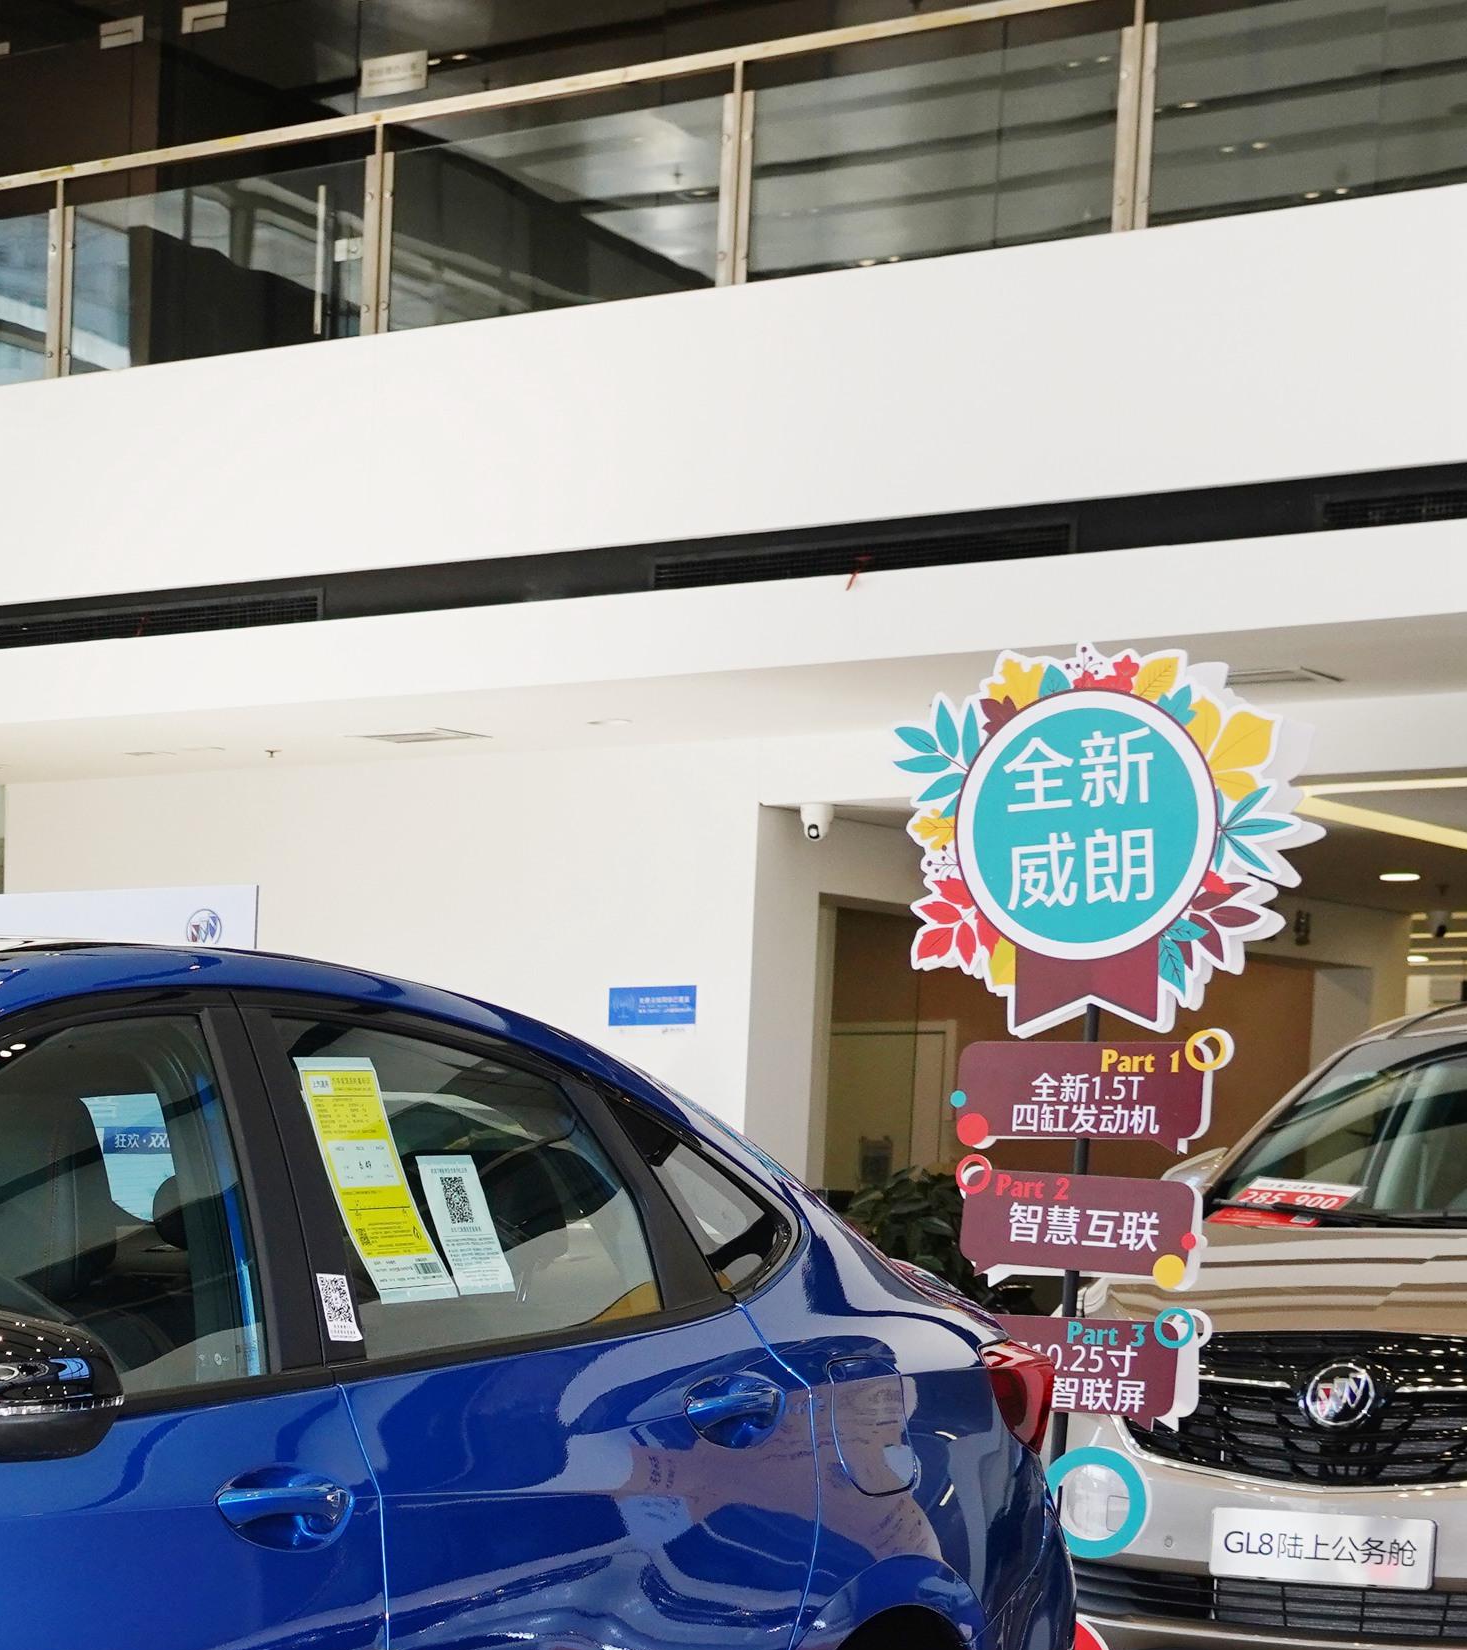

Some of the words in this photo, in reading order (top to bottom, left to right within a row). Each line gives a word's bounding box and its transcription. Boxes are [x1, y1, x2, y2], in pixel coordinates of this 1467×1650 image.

[1003, 726, 1155, 813] 全新
[1007, 828, 1156, 911] 威朗
[1100, 1049, 1156, 1073] Part
[1170, 1050, 1181, 1073] 1
[1031, 1072, 1146, 1103] 全新1.5T
[1011, 1103, 1161, 1135] 四缸发动机
[995, 1173, 1046, 1199] Part
[1052, 1177, 1072, 1201] 2
[1009, 1202, 1161, 1253] 智慧互联
[1067, 1321, 1119, 1346] Part
[1130, 1323, 1147, 1348] 3
[1223, 1531, 1418, 1568] GL8陆上公务舱
